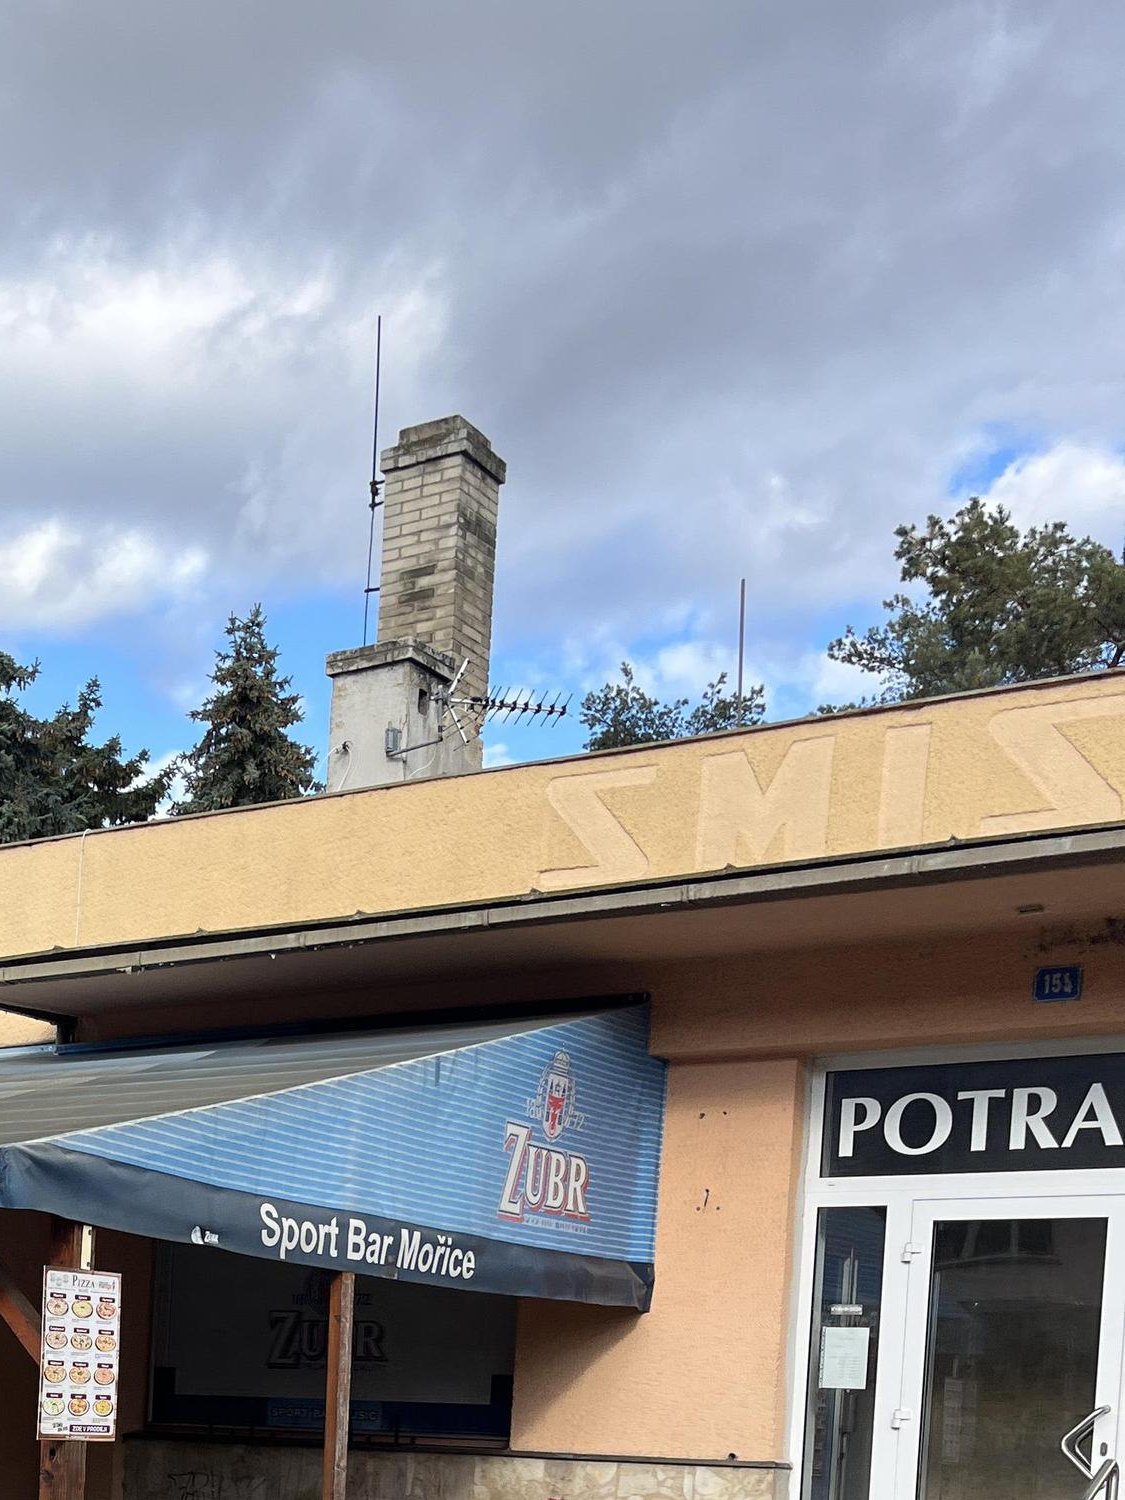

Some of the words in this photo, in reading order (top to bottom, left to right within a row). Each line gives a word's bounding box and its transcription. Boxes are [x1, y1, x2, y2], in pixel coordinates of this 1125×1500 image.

[838, 1082, 1124, 1158] POTRA
[497, 1121, 591, 1223] ZUBR
[259, 1202, 340, 1260] Sport
[346, 1218, 394, 1265] Bar
[396, 1228, 476, 1280] Mořice
[265, 1310, 388, 1369] ZUR
